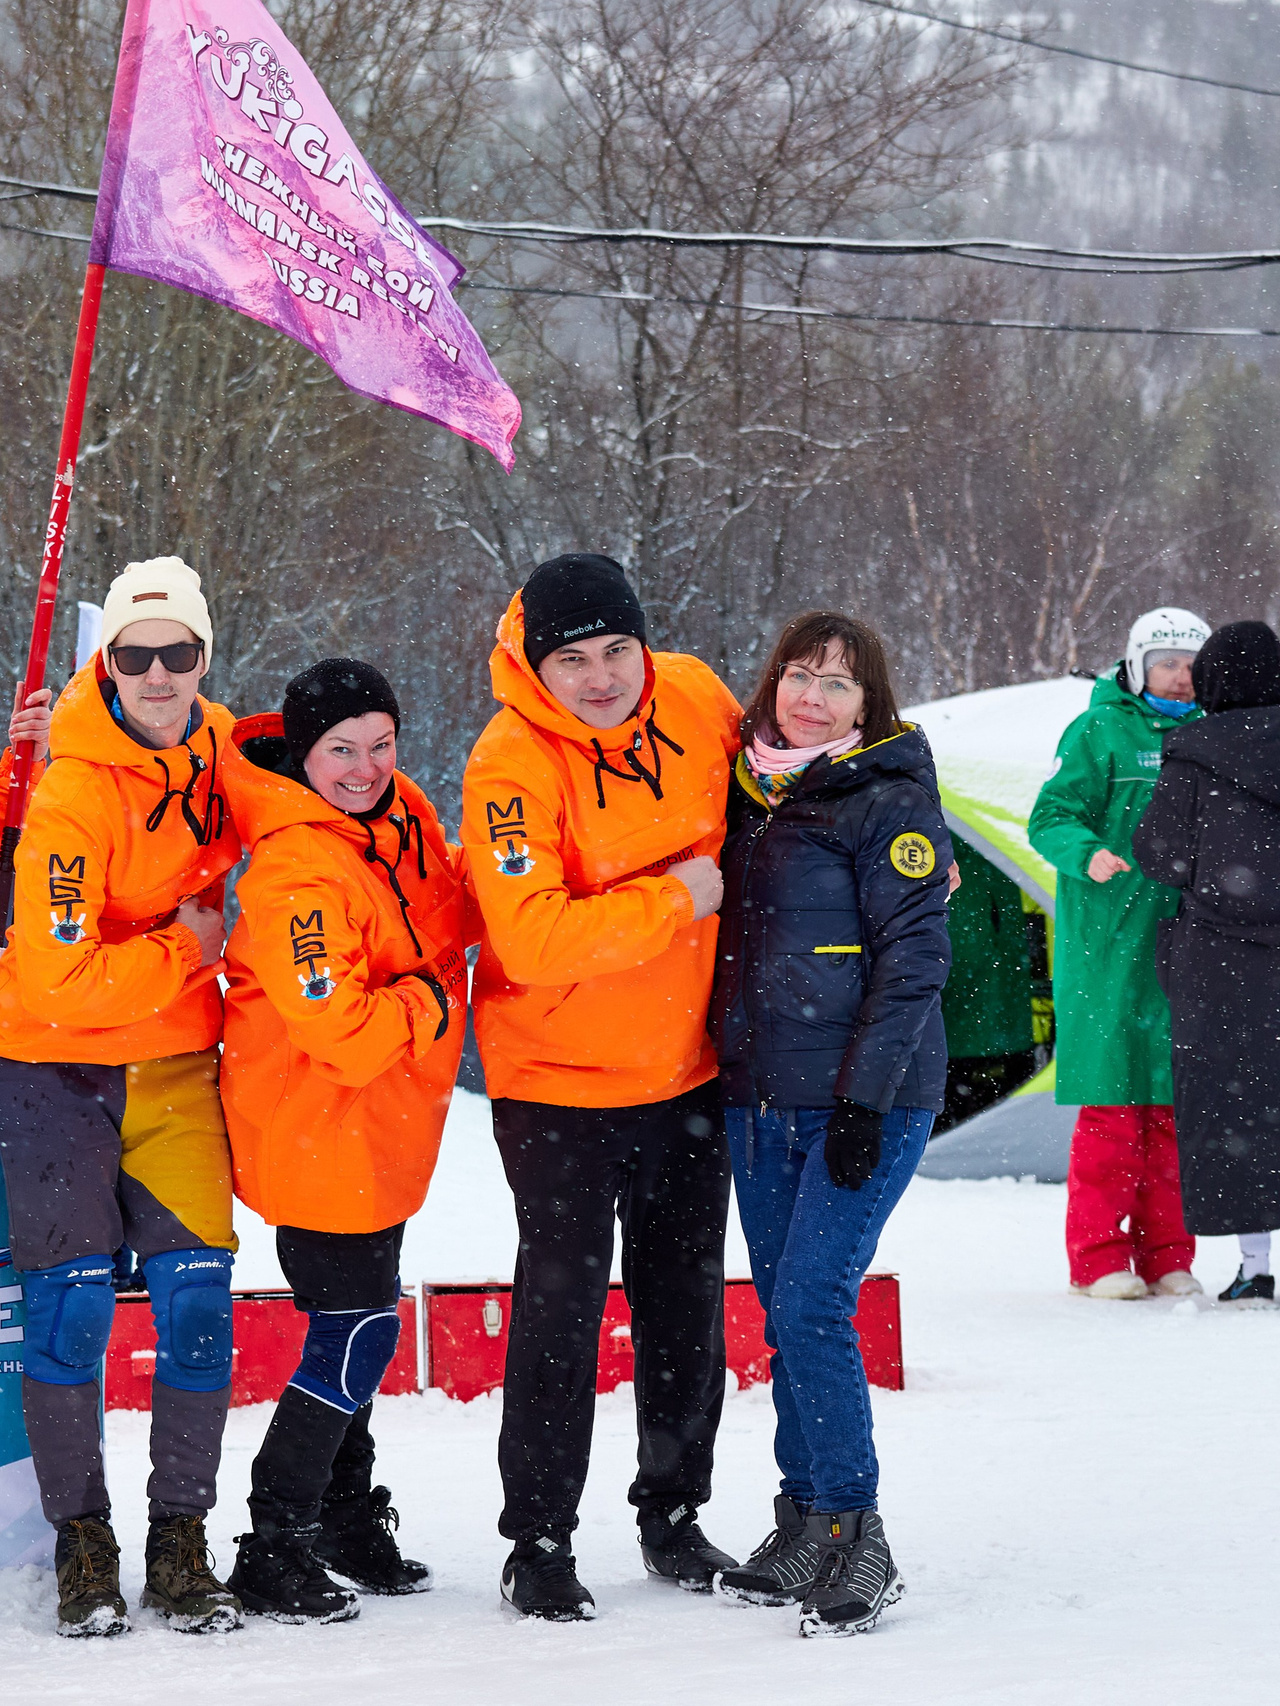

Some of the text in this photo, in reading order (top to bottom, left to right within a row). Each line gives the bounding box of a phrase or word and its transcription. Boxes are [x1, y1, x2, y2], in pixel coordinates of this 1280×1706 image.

[200, 152, 346, 277] MURMANSK
[261, 249, 360, 320] USSIA
[366, 253, 436, 315] БОЙ
[563, 622, 595, 639] Reebok
[907, 848, 919, 863] E
[668, 1503, 688, 1526] NIKE
[535, 1536, 559, 1553] NIKE
